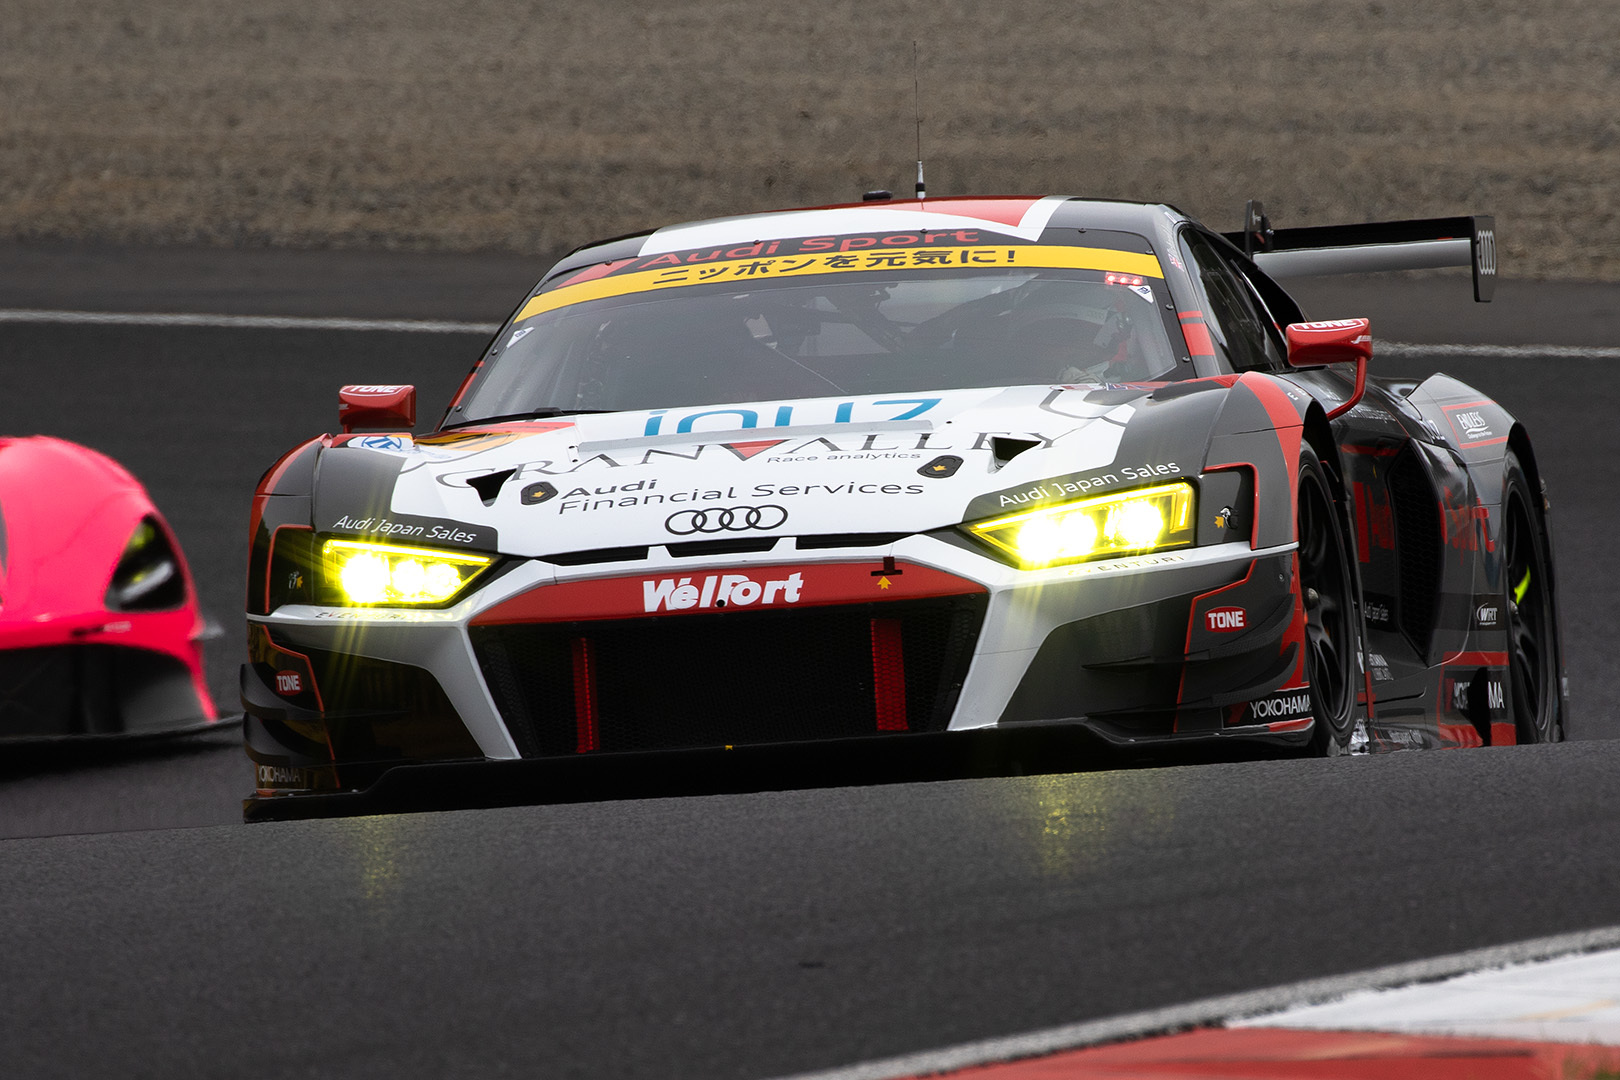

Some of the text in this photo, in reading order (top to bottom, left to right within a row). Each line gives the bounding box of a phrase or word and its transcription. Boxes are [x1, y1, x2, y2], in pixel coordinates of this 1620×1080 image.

[637, 228, 979, 269] Audi Sport
[652, 248, 1015, 285] ニッポンを元気に!
[766, 452, 922, 464] Race analytics
[560, 478, 658, 500] Audi
[999, 461, 1182, 508] Audi Japan Sales
[558, 481, 925, 515] Financial Services
[333, 514, 477, 544] Audi Japan Sales
[1208, 609, 1244, 629] TONE
[1480, 607, 1498, 621] WRT
[276, 674, 301, 692] TONE
